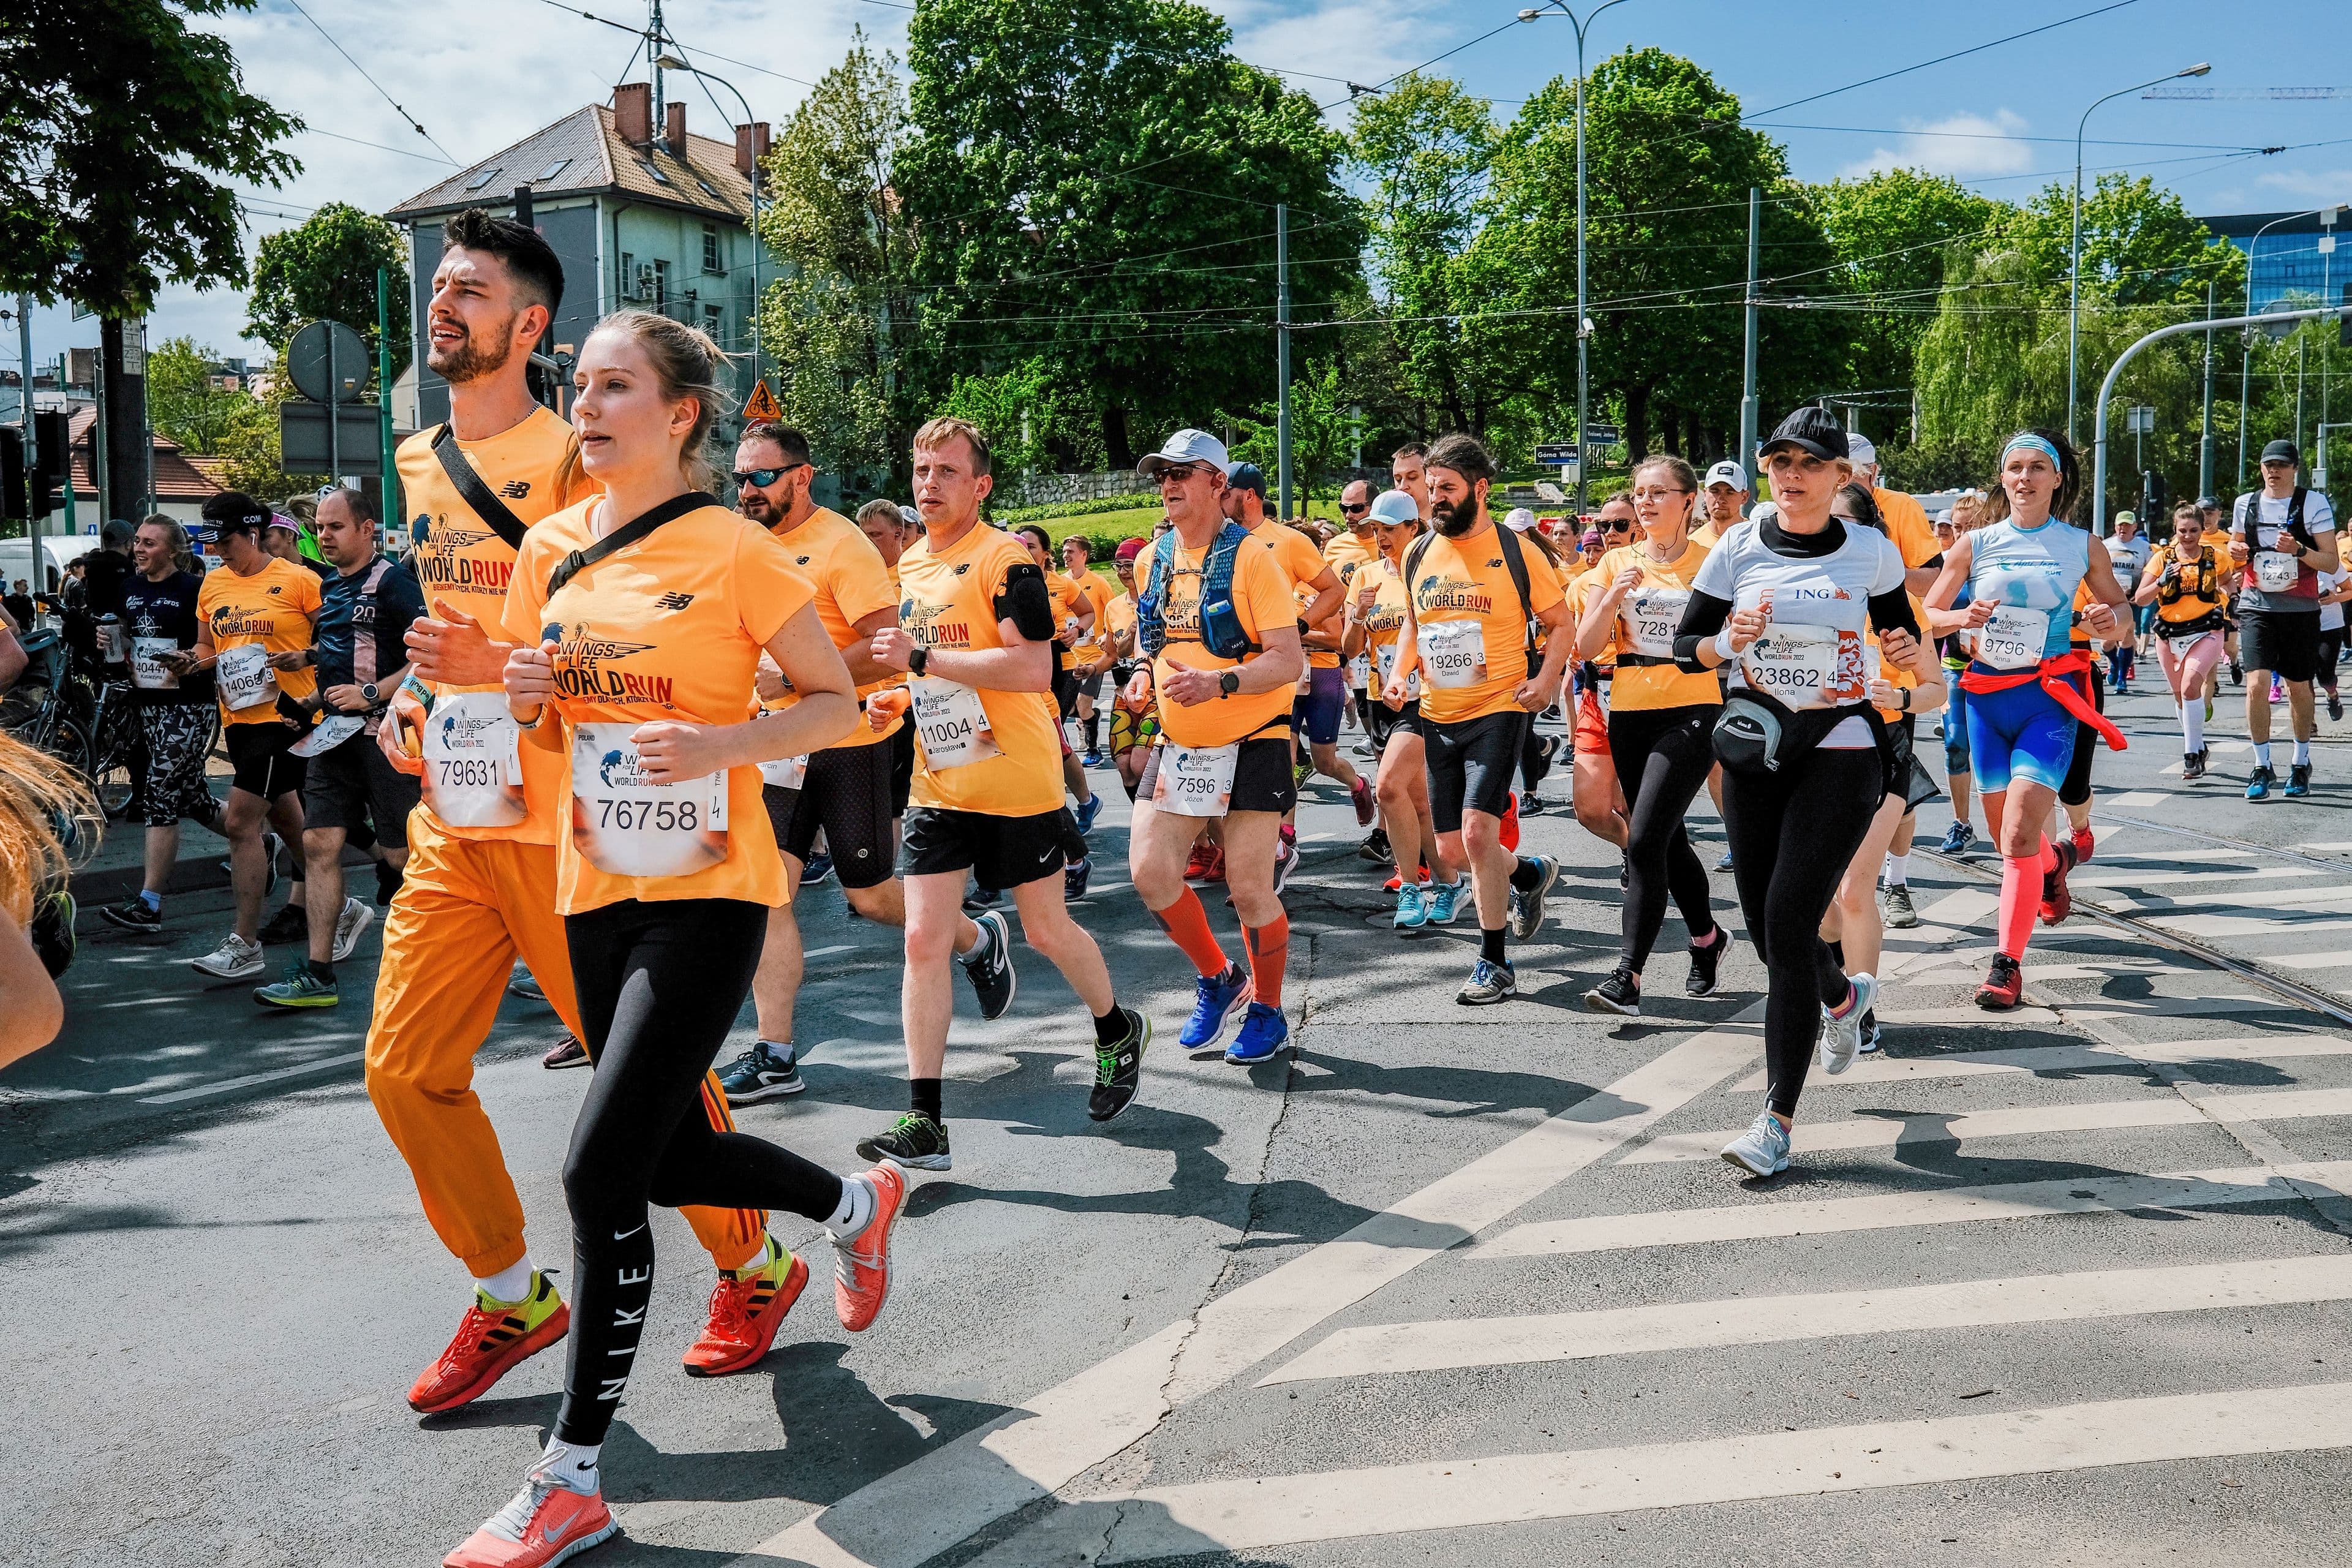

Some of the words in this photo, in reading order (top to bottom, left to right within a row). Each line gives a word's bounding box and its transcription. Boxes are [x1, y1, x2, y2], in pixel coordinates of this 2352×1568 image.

[429, 532, 467, 544] WINGS
[436, 545, 456, 557] LIFE
[2263, 571, 2290, 580] 12743
[1794, 589, 1830, 600] ING
[1426, 595, 1465, 608] WORLD
[1466, 595, 1492, 609] RUN
[911, 608, 934, 618] WINGS
[914, 617, 927, 627] LIFE
[1372, 616, 1404, 631] WORLD
[938, 623, 970, 643] RUN
[1638, 620, 1676, 637] 7281
[1642, 637, 1673, 646] Marcelina
[1985, 638, 2025, 655] 9796
[559, 642, 616, 657] WINGS
[2035, 646, 2042, 655] 4
[568, 656, 598, 669] LIFE
[1429, 653, 1472, 669] 19266
[1477, 652, 1484, 662] 3
[225, 673, 263, 693] 14065
[1752, 667, 1819, 687] 23862
[1827, 671, 1836, 685] 4
[921, 695, 944, 705] WINGS
[456, 720, 481, 729] WINGS
[978, 714, 987, 726] 4
[461, 729, 475, 739] LIFE
[921, 718, 973, 744] 11004
[932, 744, 962, 754] Jarosław
[440, 760, 497, 786] 79631
[630, 766, 649, 776] LIF
[614, 777, 638, 786] WORLD
[1177, 777, 1216, 794] 7596
[1225, 780, 1232, 791] 3
[712, 796, 720, 818] 4
[597, 799, 698, 831] 76758
[597, 1264, 650, 1400] NIKE
